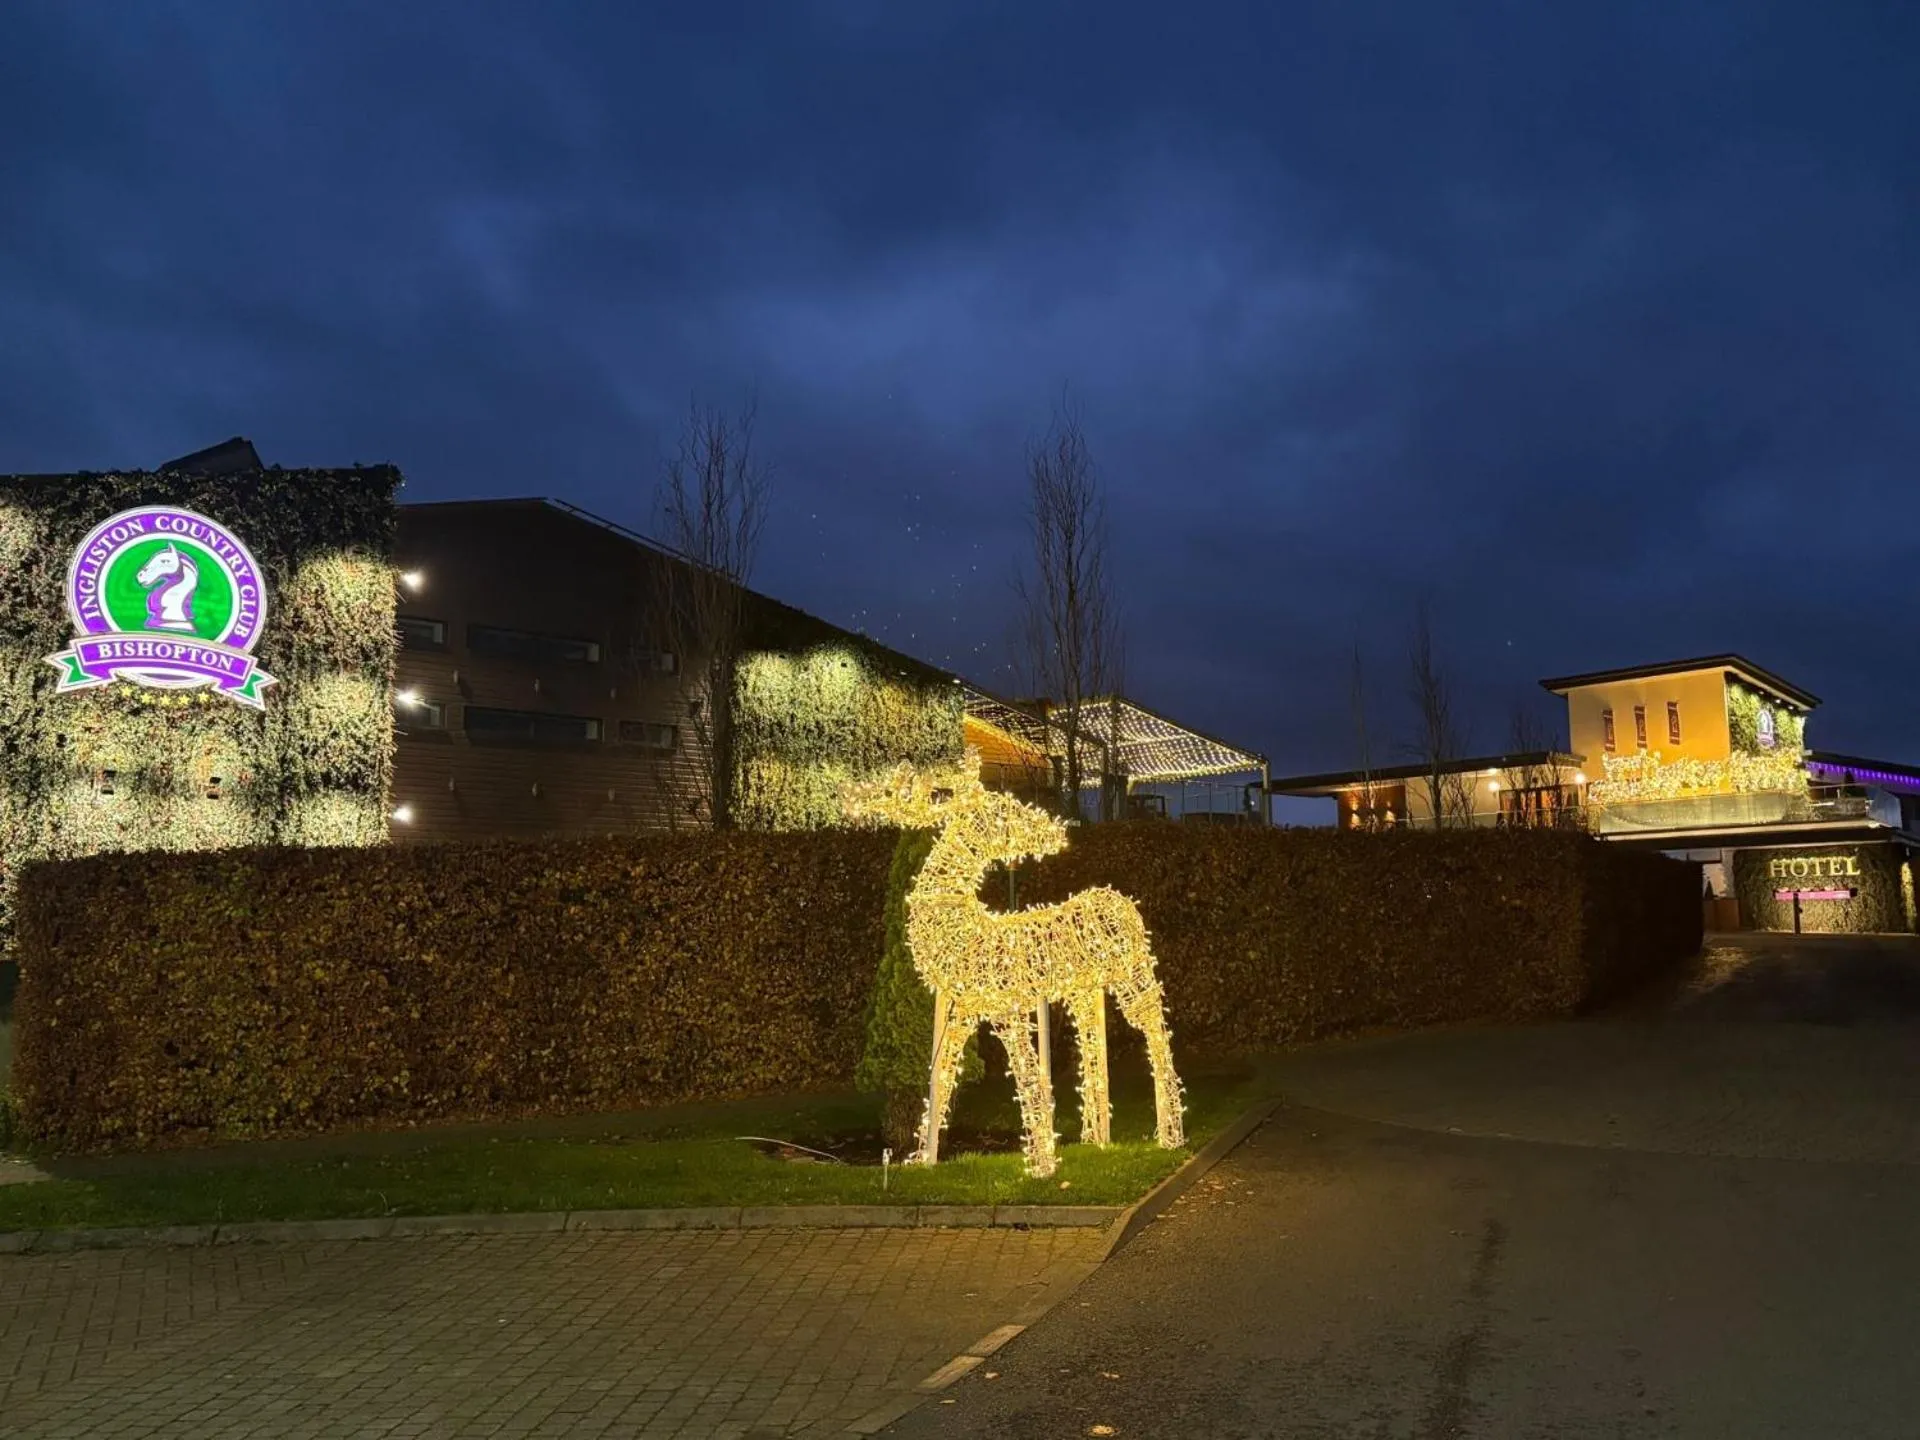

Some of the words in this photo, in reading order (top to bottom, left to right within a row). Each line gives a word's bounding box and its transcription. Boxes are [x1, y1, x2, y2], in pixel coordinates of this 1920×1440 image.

[80, 519, 144, 619] INGLISTON
[155, 516, 251, 579] COUNTRY
[234, 586, 256, 638] CLUB
[98, 642, 234, 671] BISHOPTON
[1770, 856, 1861, 878] HOTEL
